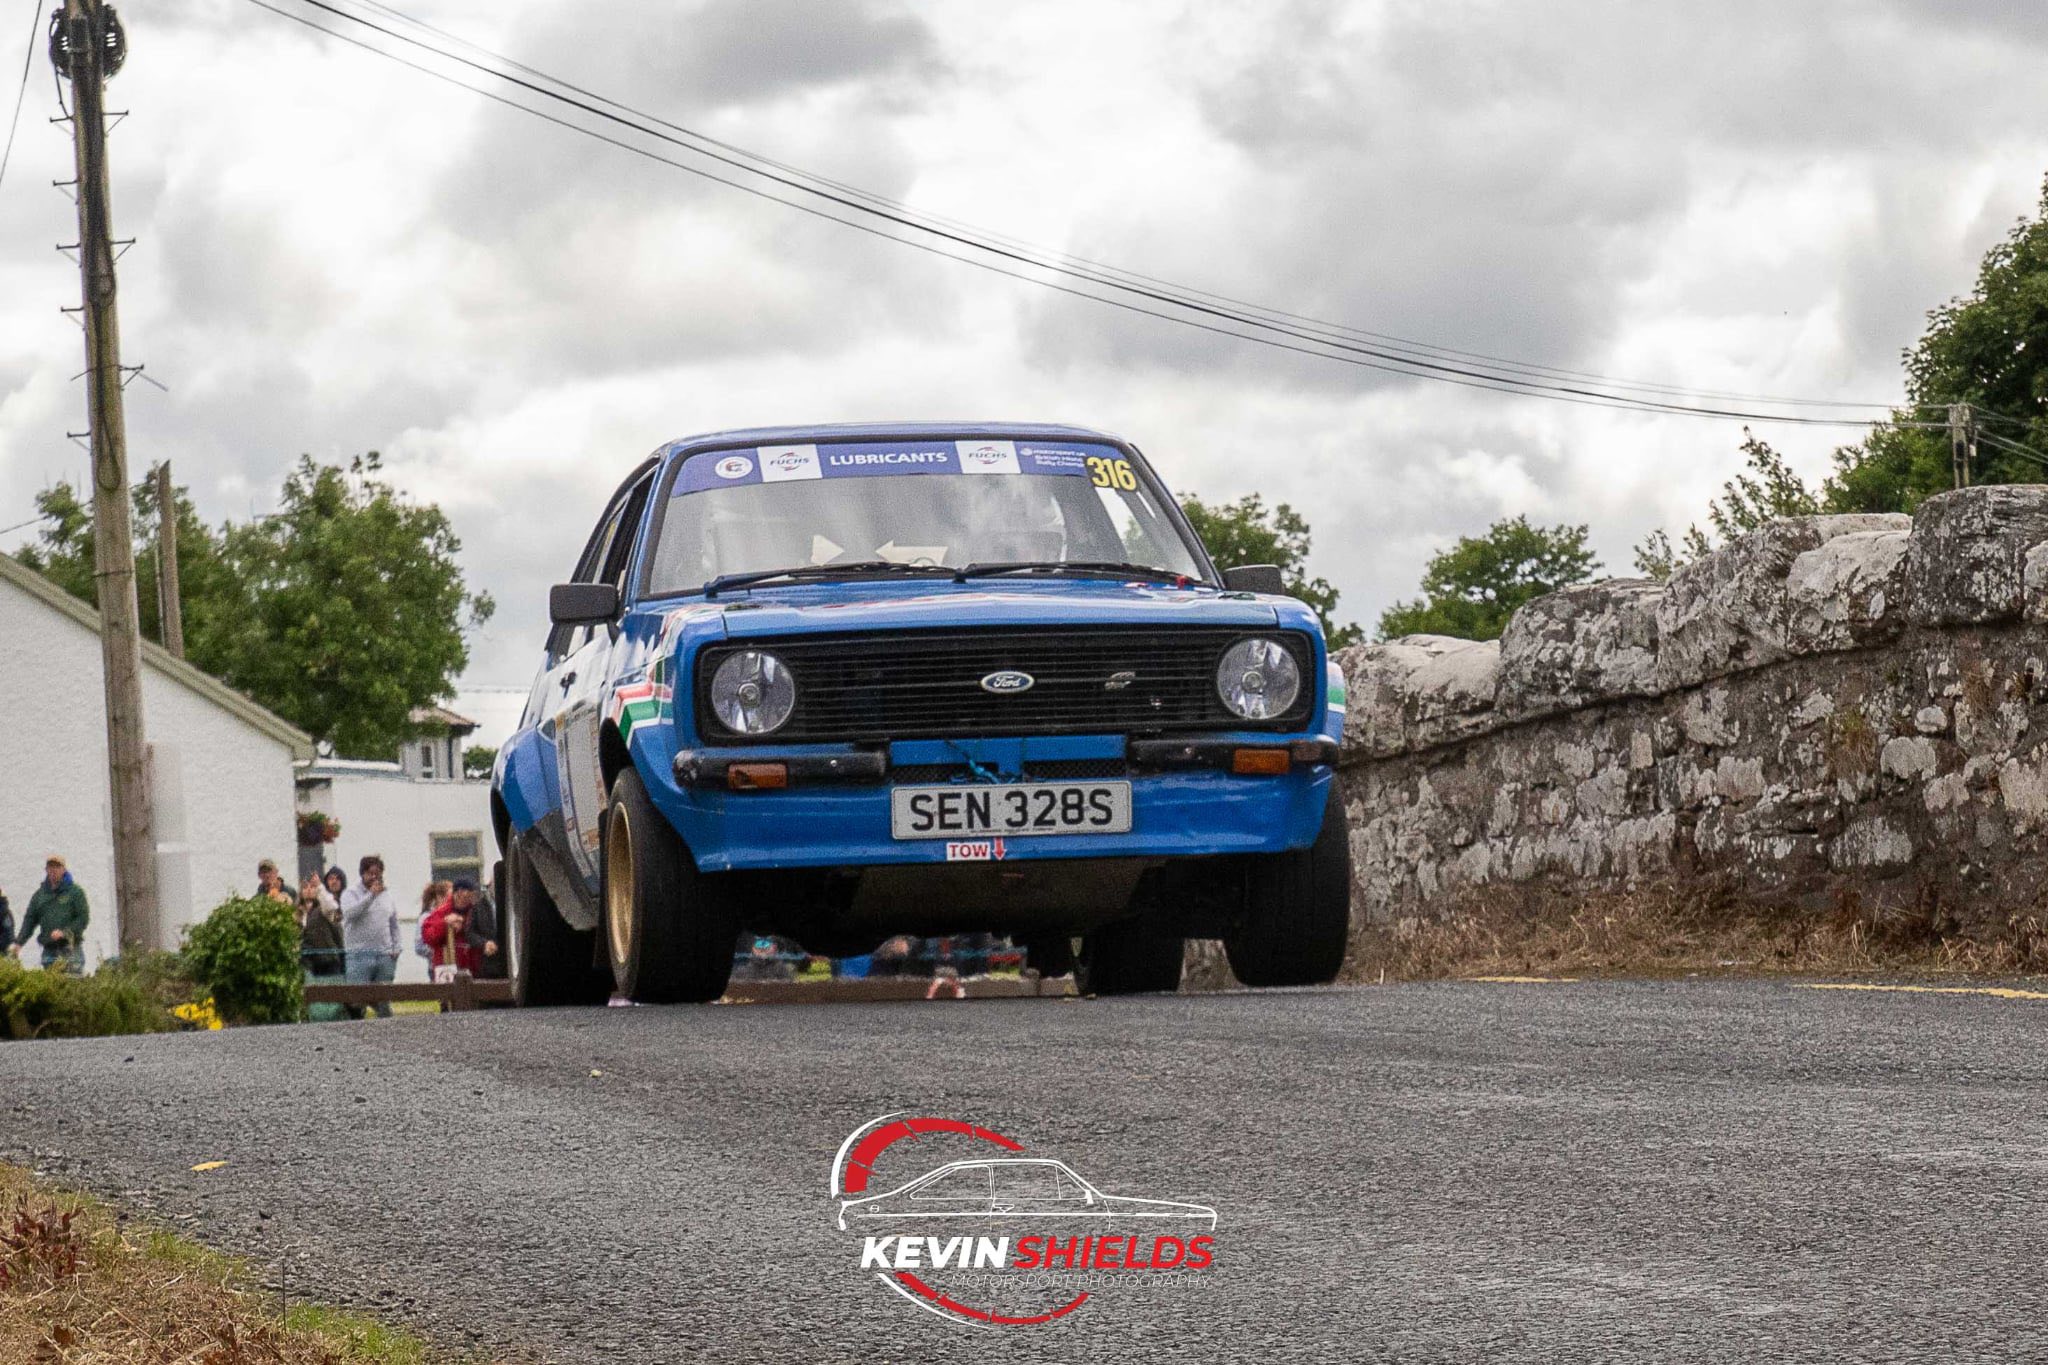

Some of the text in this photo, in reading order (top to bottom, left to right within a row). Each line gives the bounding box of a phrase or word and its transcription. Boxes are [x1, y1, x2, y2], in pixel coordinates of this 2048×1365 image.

[769, 457, 810, 466] FUCHS
[830, 452, 948, 466] LUBRICANTS
[968, 451, 1008, 459] FUCHS
[1087, 457, 1137, 491] 316
[993, 675, 1021, 688] Ford
[910, 788, 1113, 831] SEN 328S
[949, 844, 988, 857] TOW
